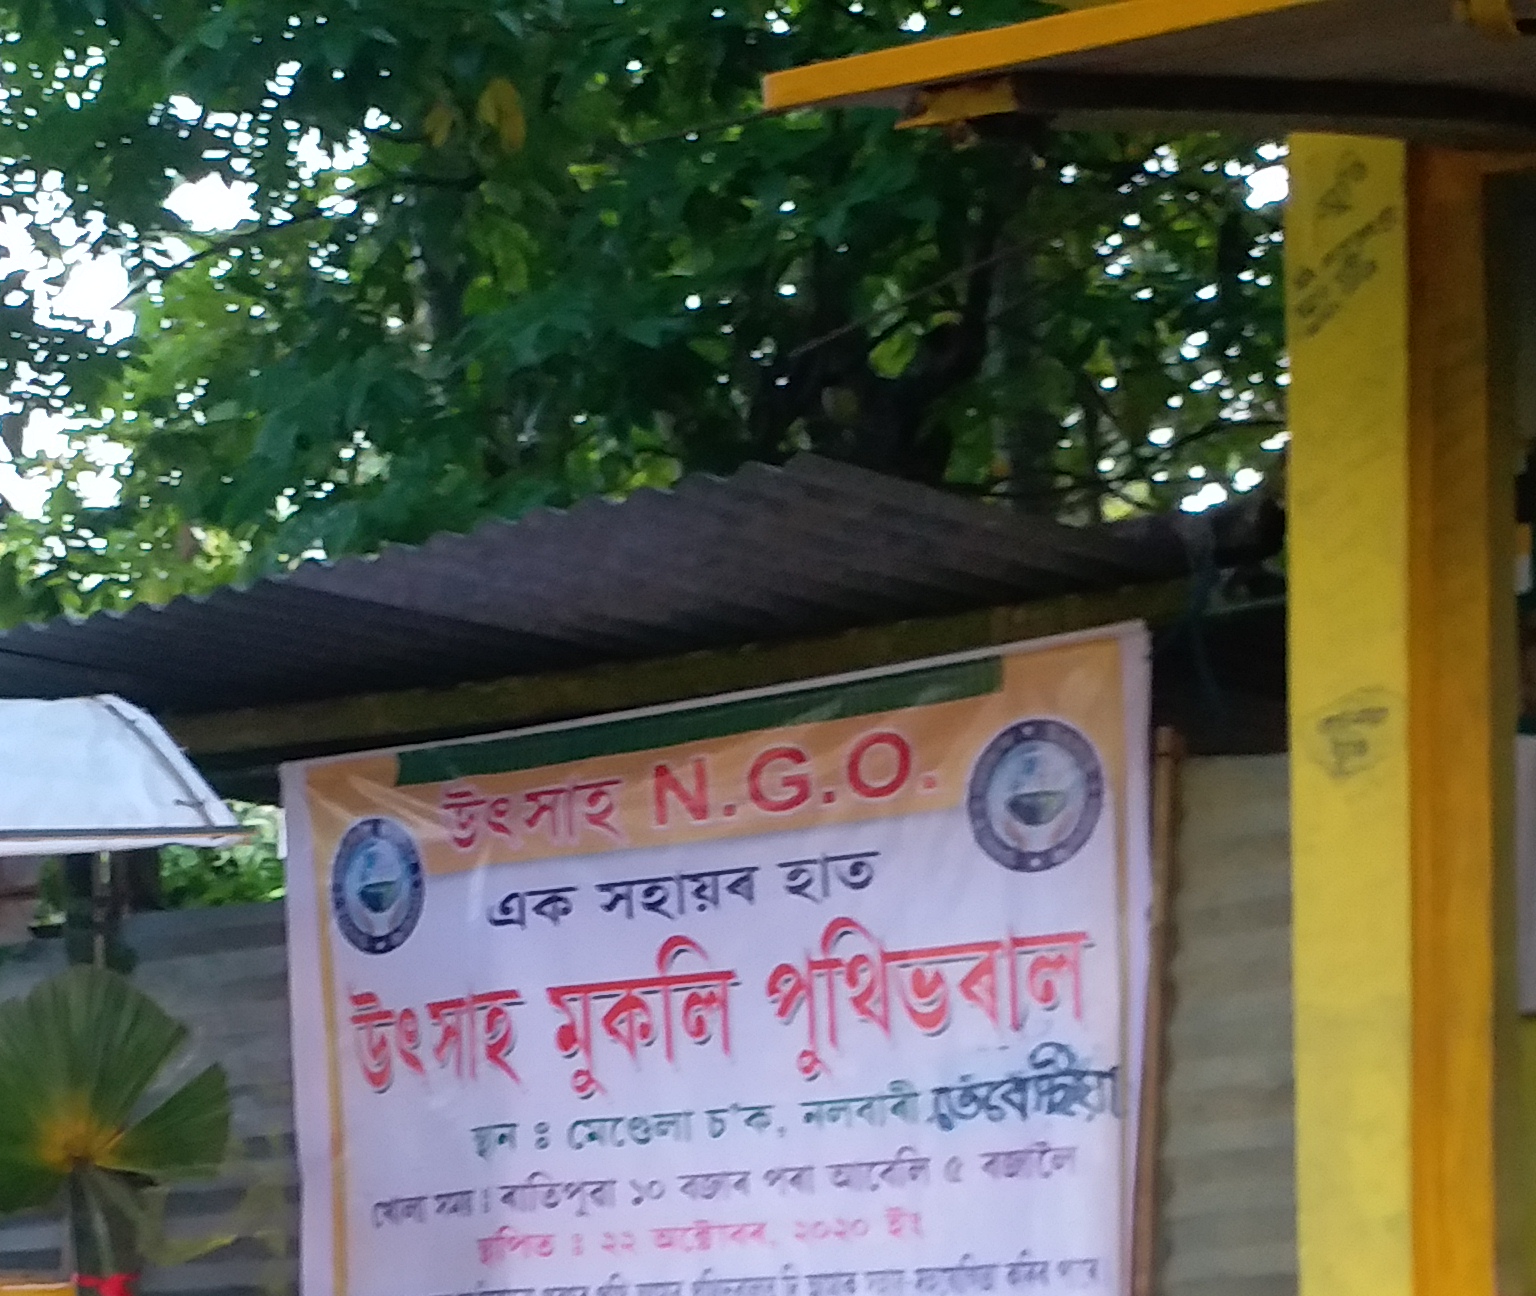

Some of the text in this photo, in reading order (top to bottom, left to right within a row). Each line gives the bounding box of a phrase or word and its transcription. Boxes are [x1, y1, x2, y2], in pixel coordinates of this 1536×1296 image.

[442, 731, 937, 847] উৎসাহ N.G.O.
[488, 887, 579, 929] এক
[778, 851, 880, 904] হাত
[350, 984, 525, 1093] উৎসাহ
[547, 934, 741, 1099] মুকলি
